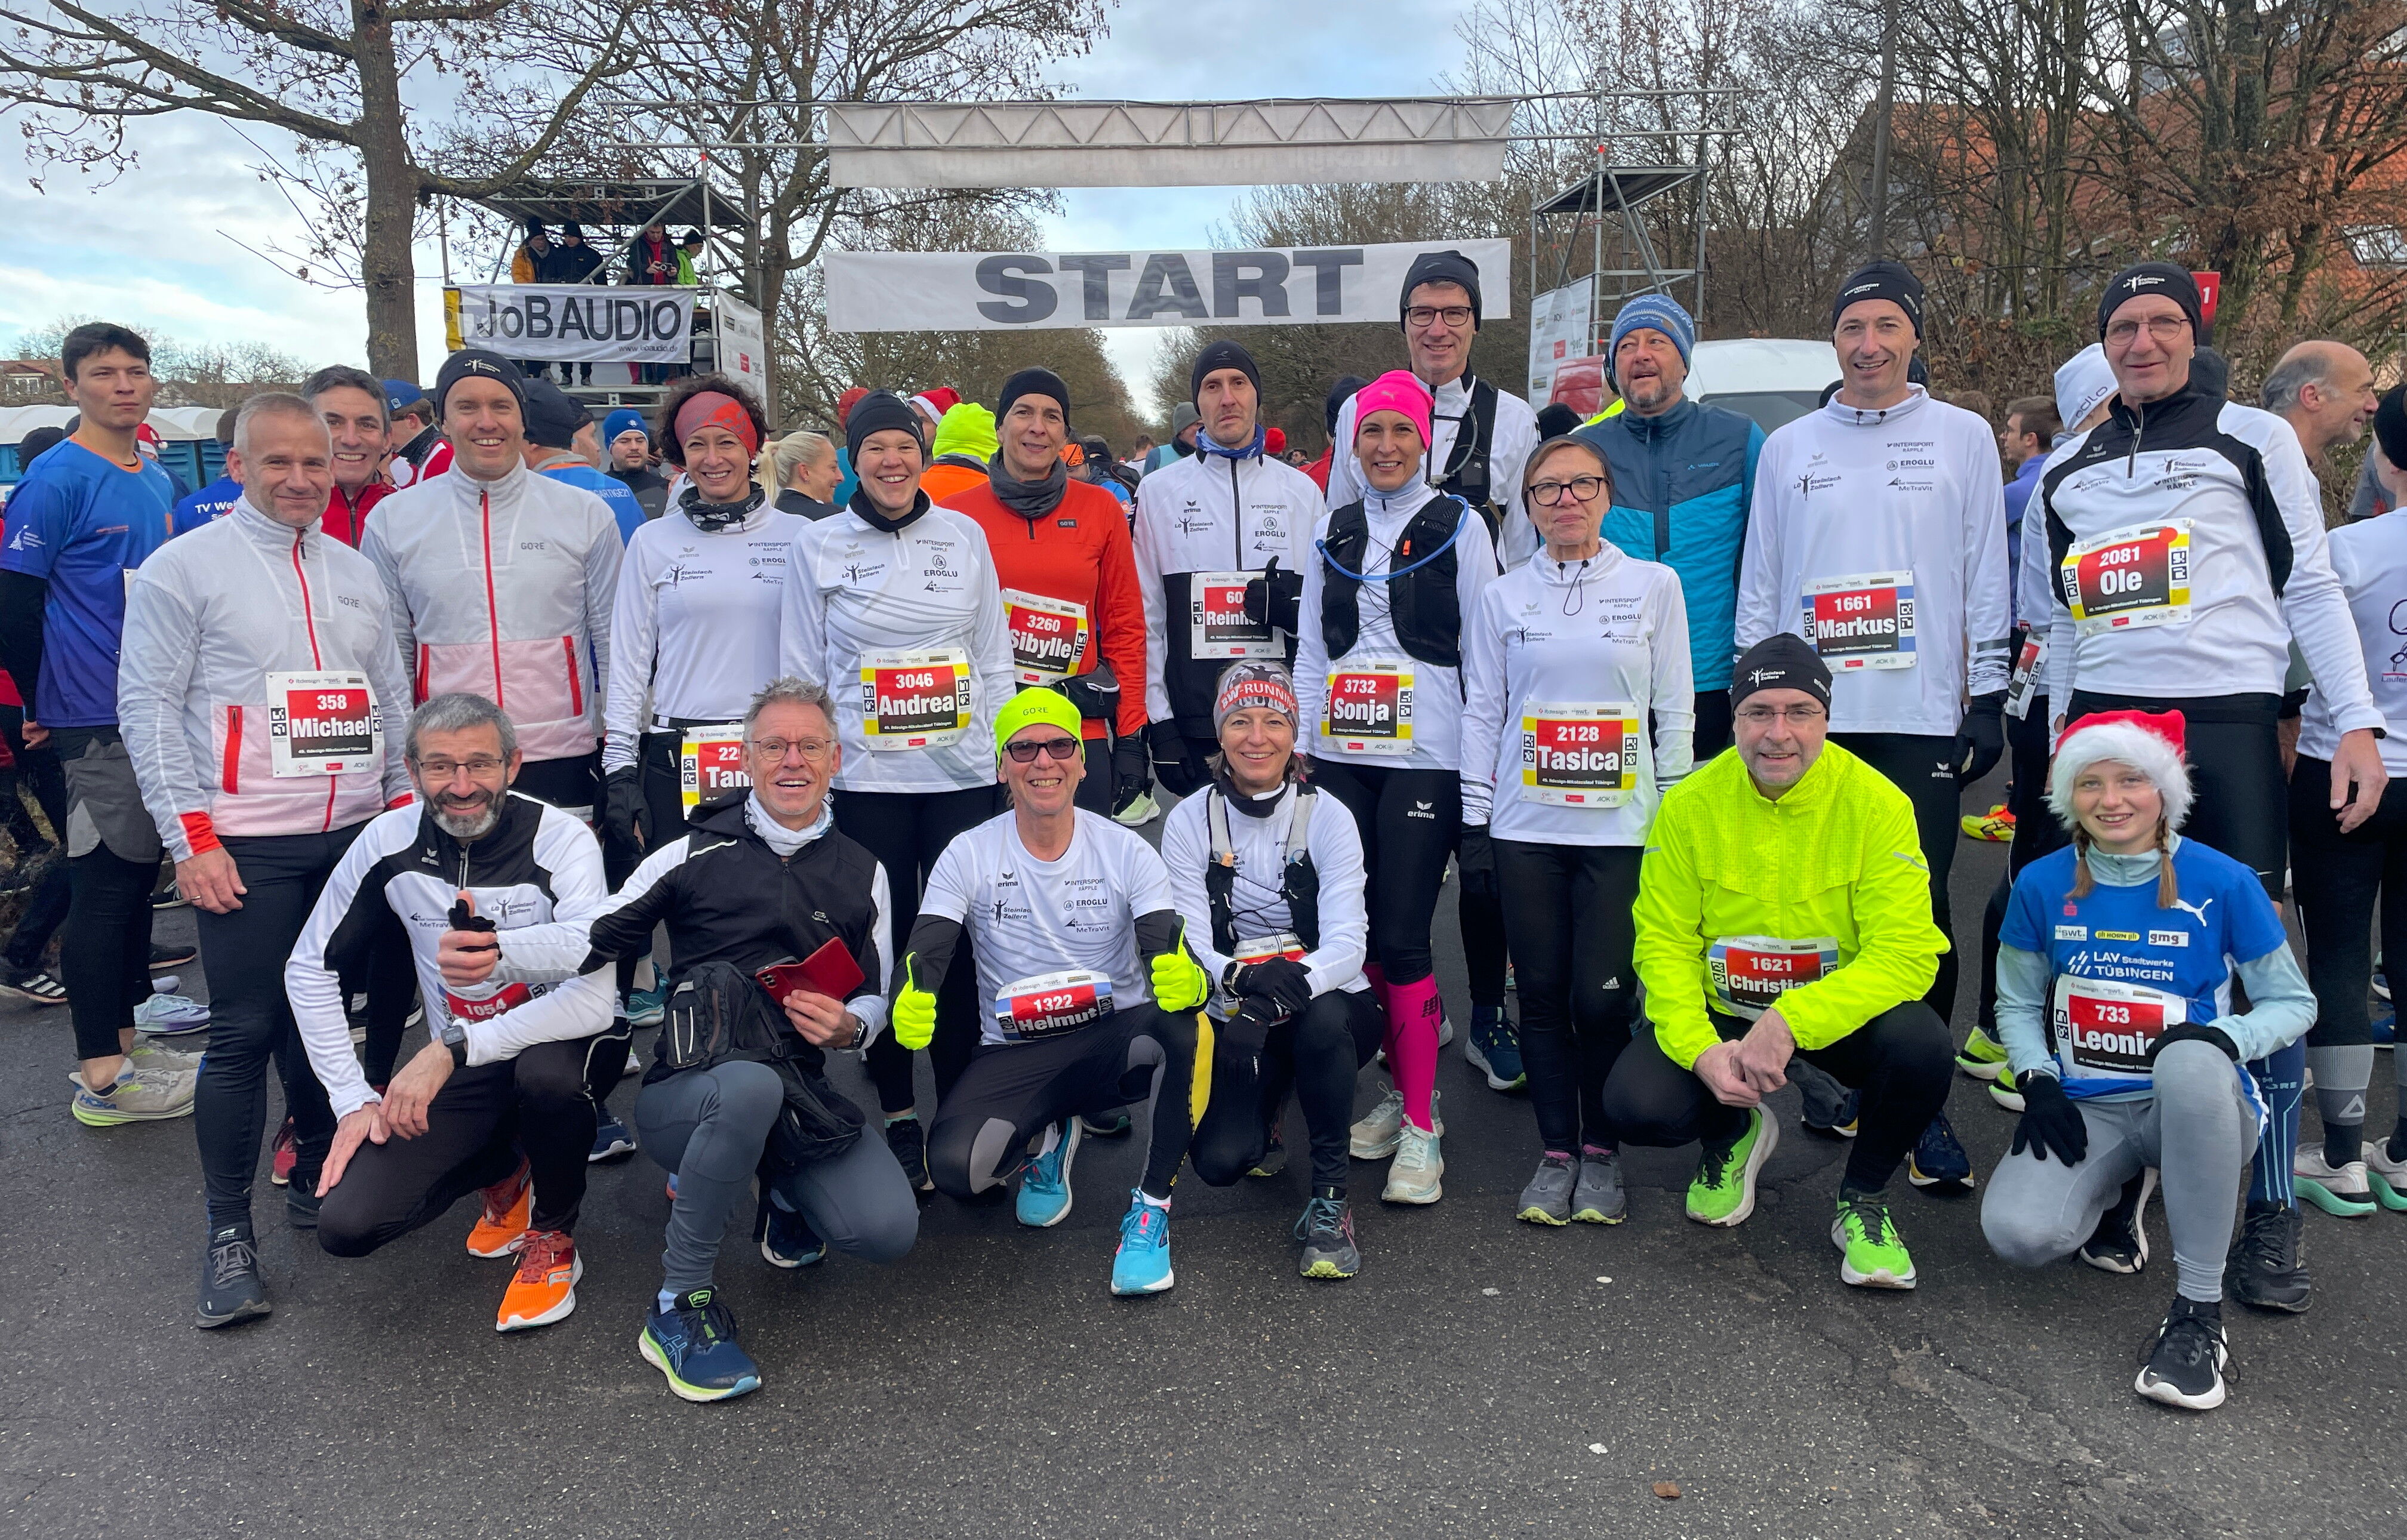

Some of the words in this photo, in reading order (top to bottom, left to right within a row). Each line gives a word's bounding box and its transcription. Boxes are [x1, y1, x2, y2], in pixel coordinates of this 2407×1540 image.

[975, 248, 1364, 324] START
[195, 503, 211, 513] TV
[2098, 546, 2140, 567] 2081
[857, 563, 885, 574] Steinlach
[924, 569, 958, 578] EROGLU
[2100, 568, 2143, 596] Ole
[338, 596, 359, 608] GORE
[1226, 591, 1245, 604] 60
[1835, 595, 1872, 612] 1661
[1027, 615, 1061, 633] 3260
[1206, 611, 1261, 626] Reinh
[1817, 616, 1896, 639] Markus
[1010, 629, 1072, 659] Sibylle
[895, 673, 934, 689] 3046
[1344, 679, 1377, 694] 3732
[317, 694, 347, 710] 358
[879, 694, 955, 716] Andrea
[1023, 707, 1049, 716] GORE
[1333, 697, 1390, 726] Sonja
[291, 716, 370, 738] Michael
[1557, 726, 1599, 742] 2128
[719, 747, 740, 761] 22
[1537, 746, 1620, 771] Tasica
[706, 766, 753, 788] Tan
[1407, 811, 1435, 820] erima
[1076, 898, 1108, 907] EROGLU
[2150, 933, 2179, 945] gmg
[1750, 957, 1792, 972] 1621
[2093, 951, 2120, 963] LAV
[2122, 956, 2174, 968] Stadtwerke
[2094, 964, 2174, 982] TÜBINGEN
[1018, 982, 1040, 991] itdesign
[1729, 974, 1811, 994] Christia
[463, 997, 507, 1017] 1054
[1033, 994, 1075, 1013] 1322
[1018, 1007, 1097, 1031] Helmut
[2095, 1004, 2130, 1024] 733
